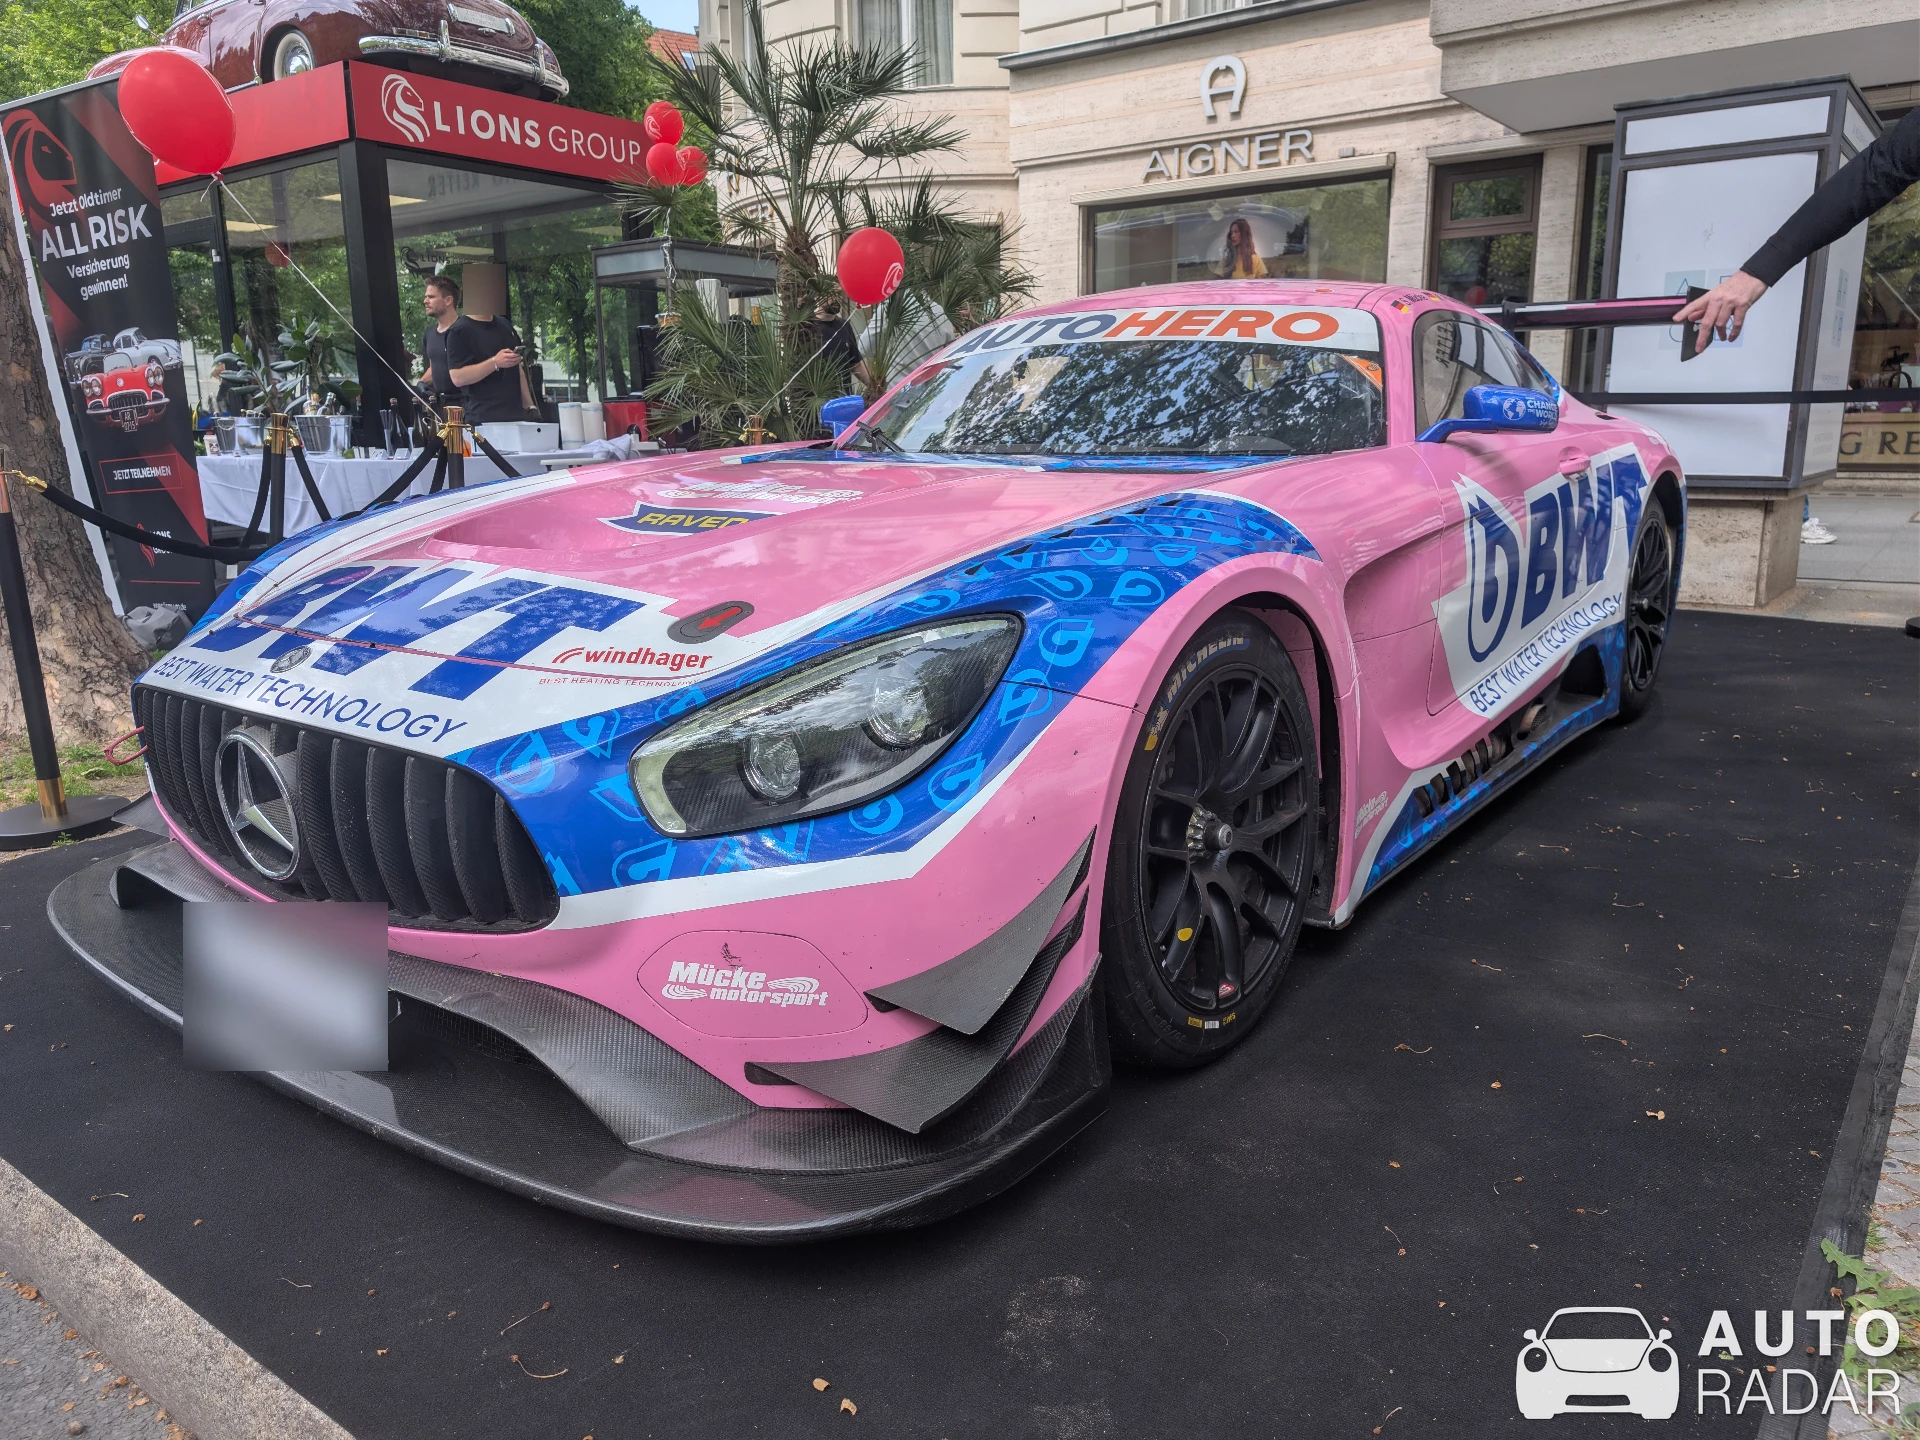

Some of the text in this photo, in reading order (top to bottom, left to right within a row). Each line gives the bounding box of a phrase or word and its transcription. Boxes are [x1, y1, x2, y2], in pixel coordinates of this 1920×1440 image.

[433, 101, 641, 165] LIONS GROUP
[1140, 129, 1314, 180] AIGNER
[49, 187, 122, 217] Jetzt Oldtimer
[42, 203, 152, 262] ALL RISK
[66, 254, 130, 279] Versicherung
[80, 274, 128, 300] gewinnen!
[949, 309, 1340, 357] AUTOHERO
[585, 647, 713, 671] windhager
[1470, 592, 1623, 713] BEST WATER TECHNOLOGY
[571, 677, 623, 686] HEATING
[154, 656, 468, 743] BEST WATER TECHNOLOGY
[668, 961, 767, 989] Mücke
[710, 987, 829, 1007] motorsport
